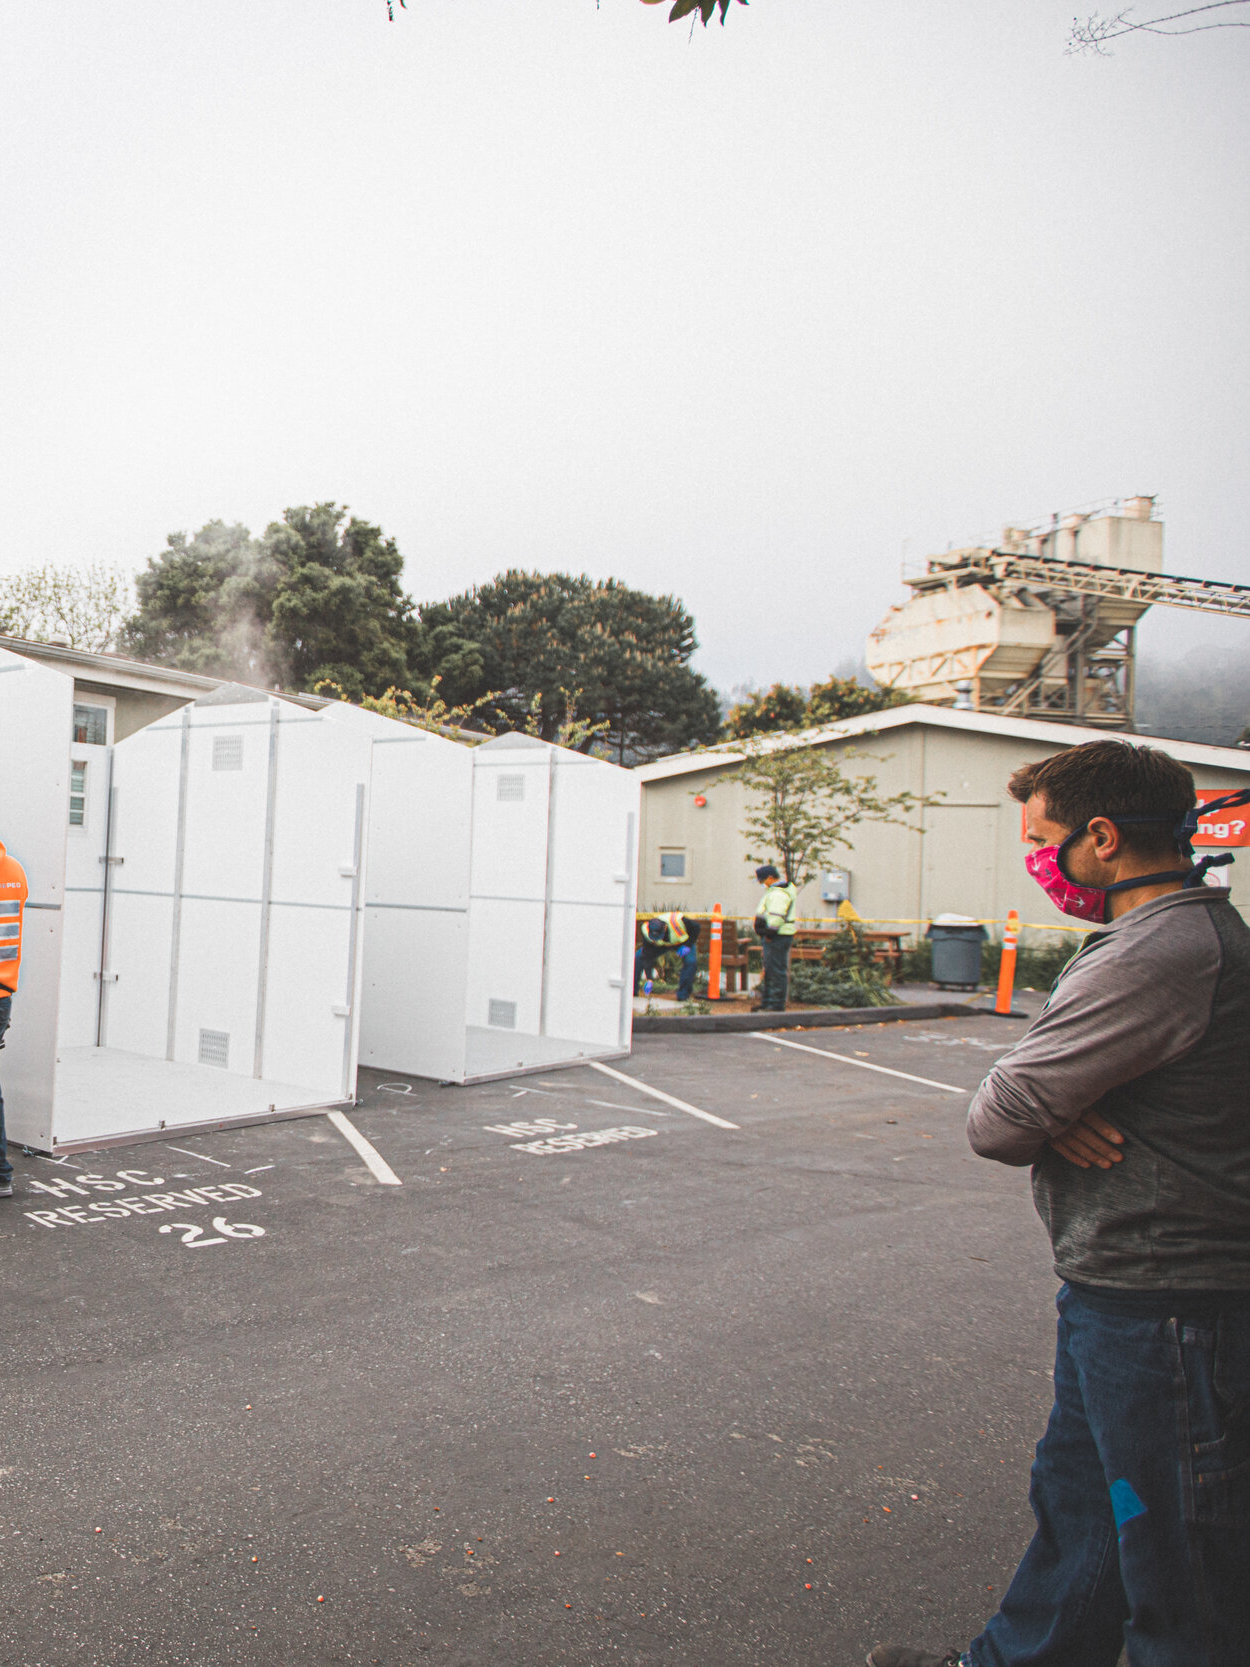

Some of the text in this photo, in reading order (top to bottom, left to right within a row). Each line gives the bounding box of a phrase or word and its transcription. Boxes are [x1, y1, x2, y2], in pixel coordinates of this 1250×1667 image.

[1198, 820, 1245, 838] ng?
[482, 1118, 579, 1138] HSC
[509, 1125, 659, 1155] RESERVED
[29, 1169, 165, 1198] HSC
[23, 1183, 263, 1228] RESERVED
[158, 1216, 266, 1248] 26
